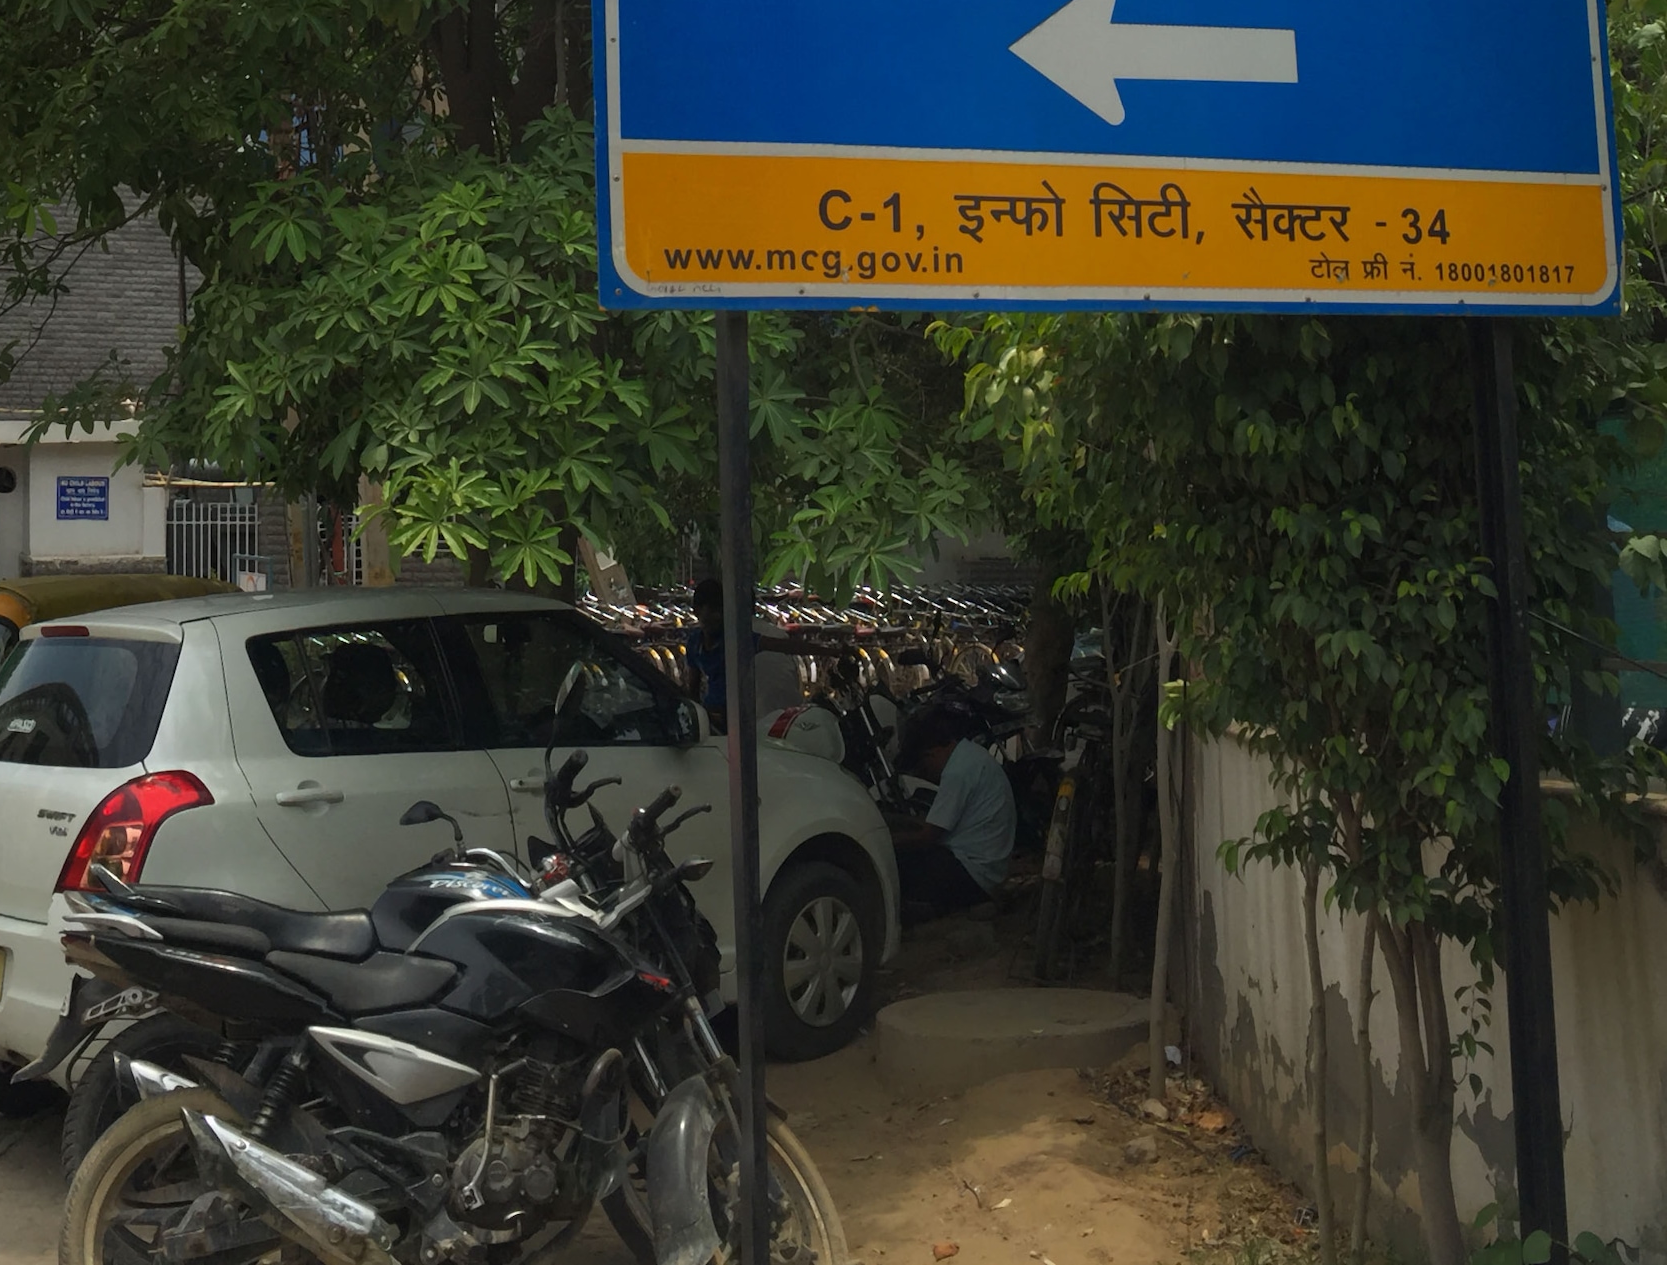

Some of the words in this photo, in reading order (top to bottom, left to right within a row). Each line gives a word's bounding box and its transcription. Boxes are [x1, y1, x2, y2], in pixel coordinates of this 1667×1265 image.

[818, 189, 925, 241] C-1,
[954, 180, 1066, 243] इन्फो
[1089, 182, 1205, 245] सिटी,
[1231, 186, 1351, 242] सैक्टर
[1400, 207, 1450, 245] 34
[663, 245, 964, 279] www.mcg.gov.in
[1310, 252, 1350, 281] टोल
[1361, 251, 1388, 282] फ्री
[1435, 262, 1575, 284] 18001801817
[37, 808, 77, 823] SWIFT
